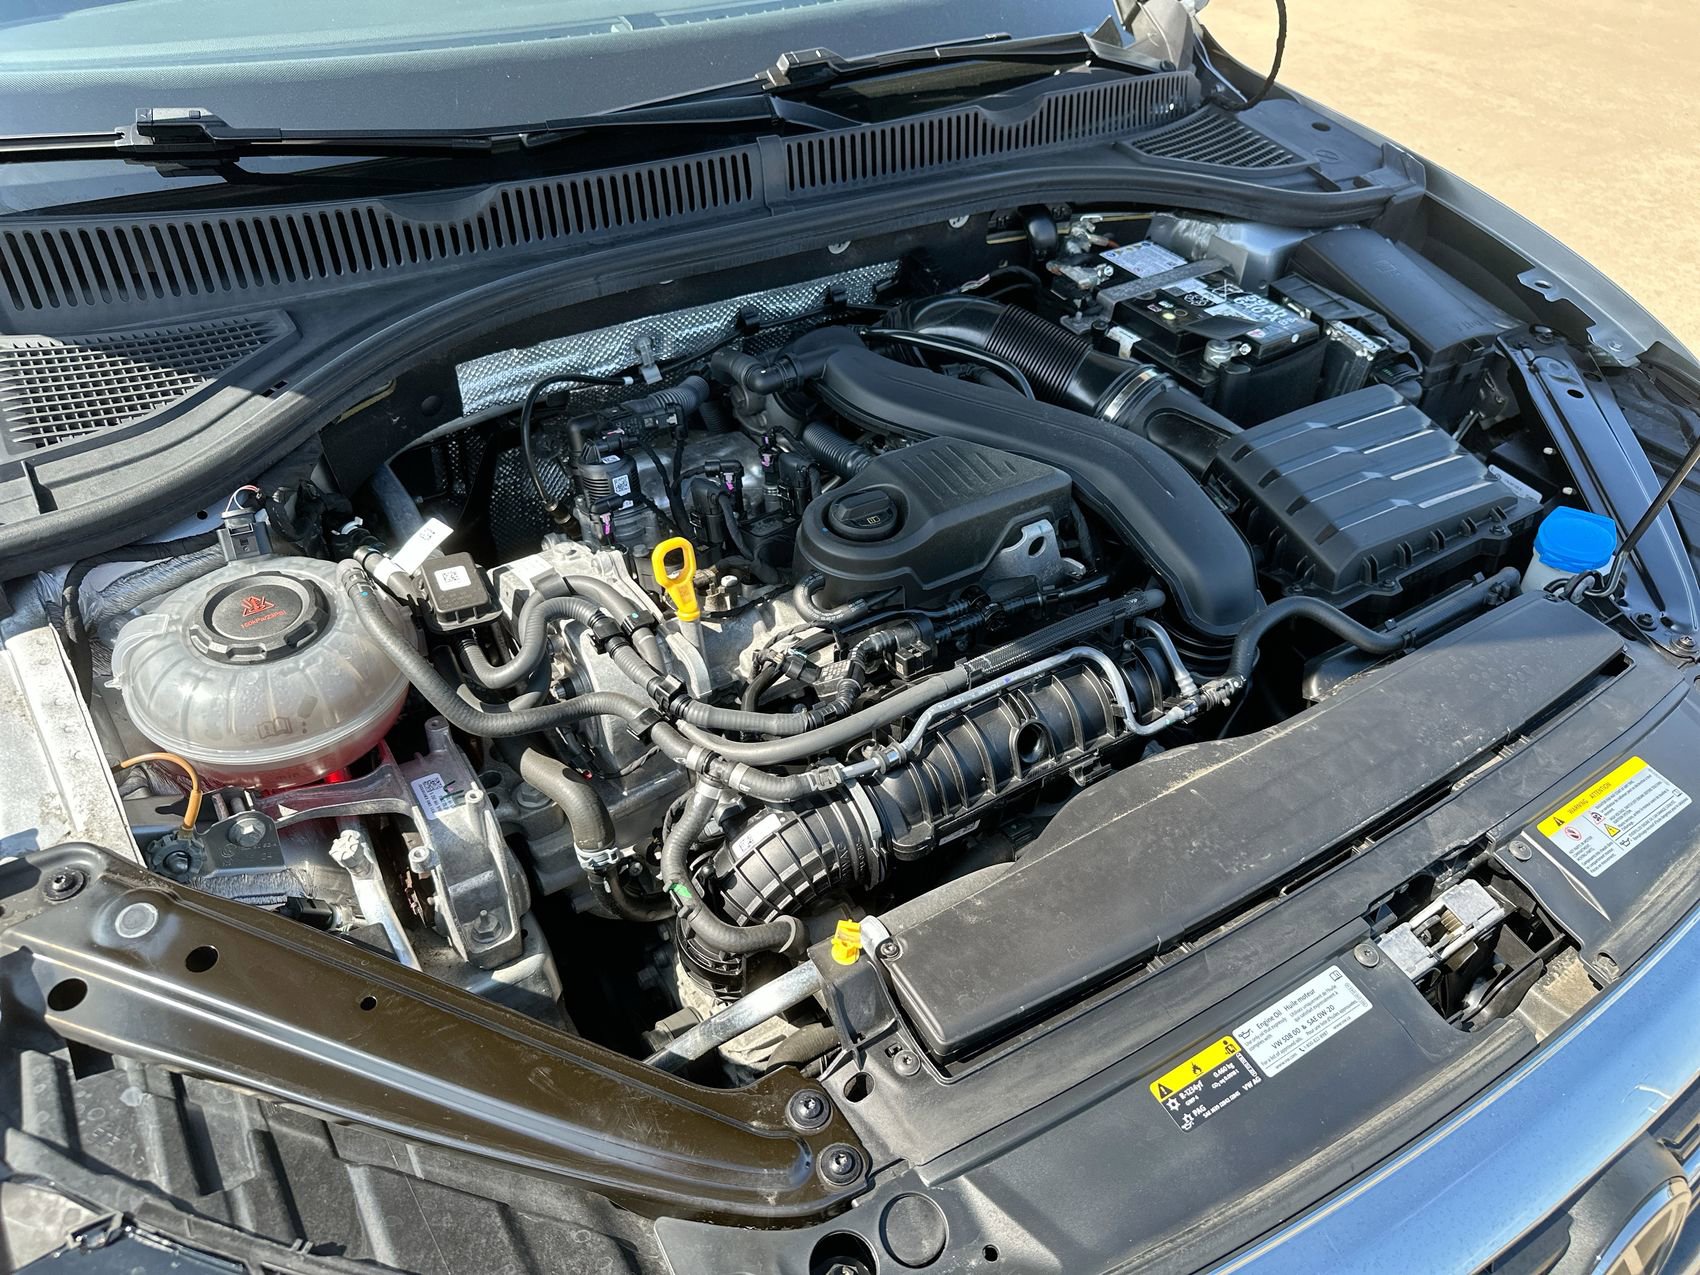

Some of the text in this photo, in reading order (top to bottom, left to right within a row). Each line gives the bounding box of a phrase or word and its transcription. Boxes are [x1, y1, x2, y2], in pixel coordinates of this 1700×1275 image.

[1568, 799, 1588, 814] WARNING
[1590, 782, 1611, 798] ATTENTION
[1256, 989, 1315, 1029] Engine Oil Huile moteur
[1272, 1040, 1282, 1049] VW
[1282, 1033, 1293, 1042] 508
[1307, 1016, 1318, 1026] SAE
[1317, 1005, 1335, 1019] 0W-20
[1179, 1080, 1203, 1099] R-1234yf
[1242, 1081, 1253, 1090] VW
[1252, 1076, 1261, 1085] AG
[1192, 1105, 1206, 1116] PAG
